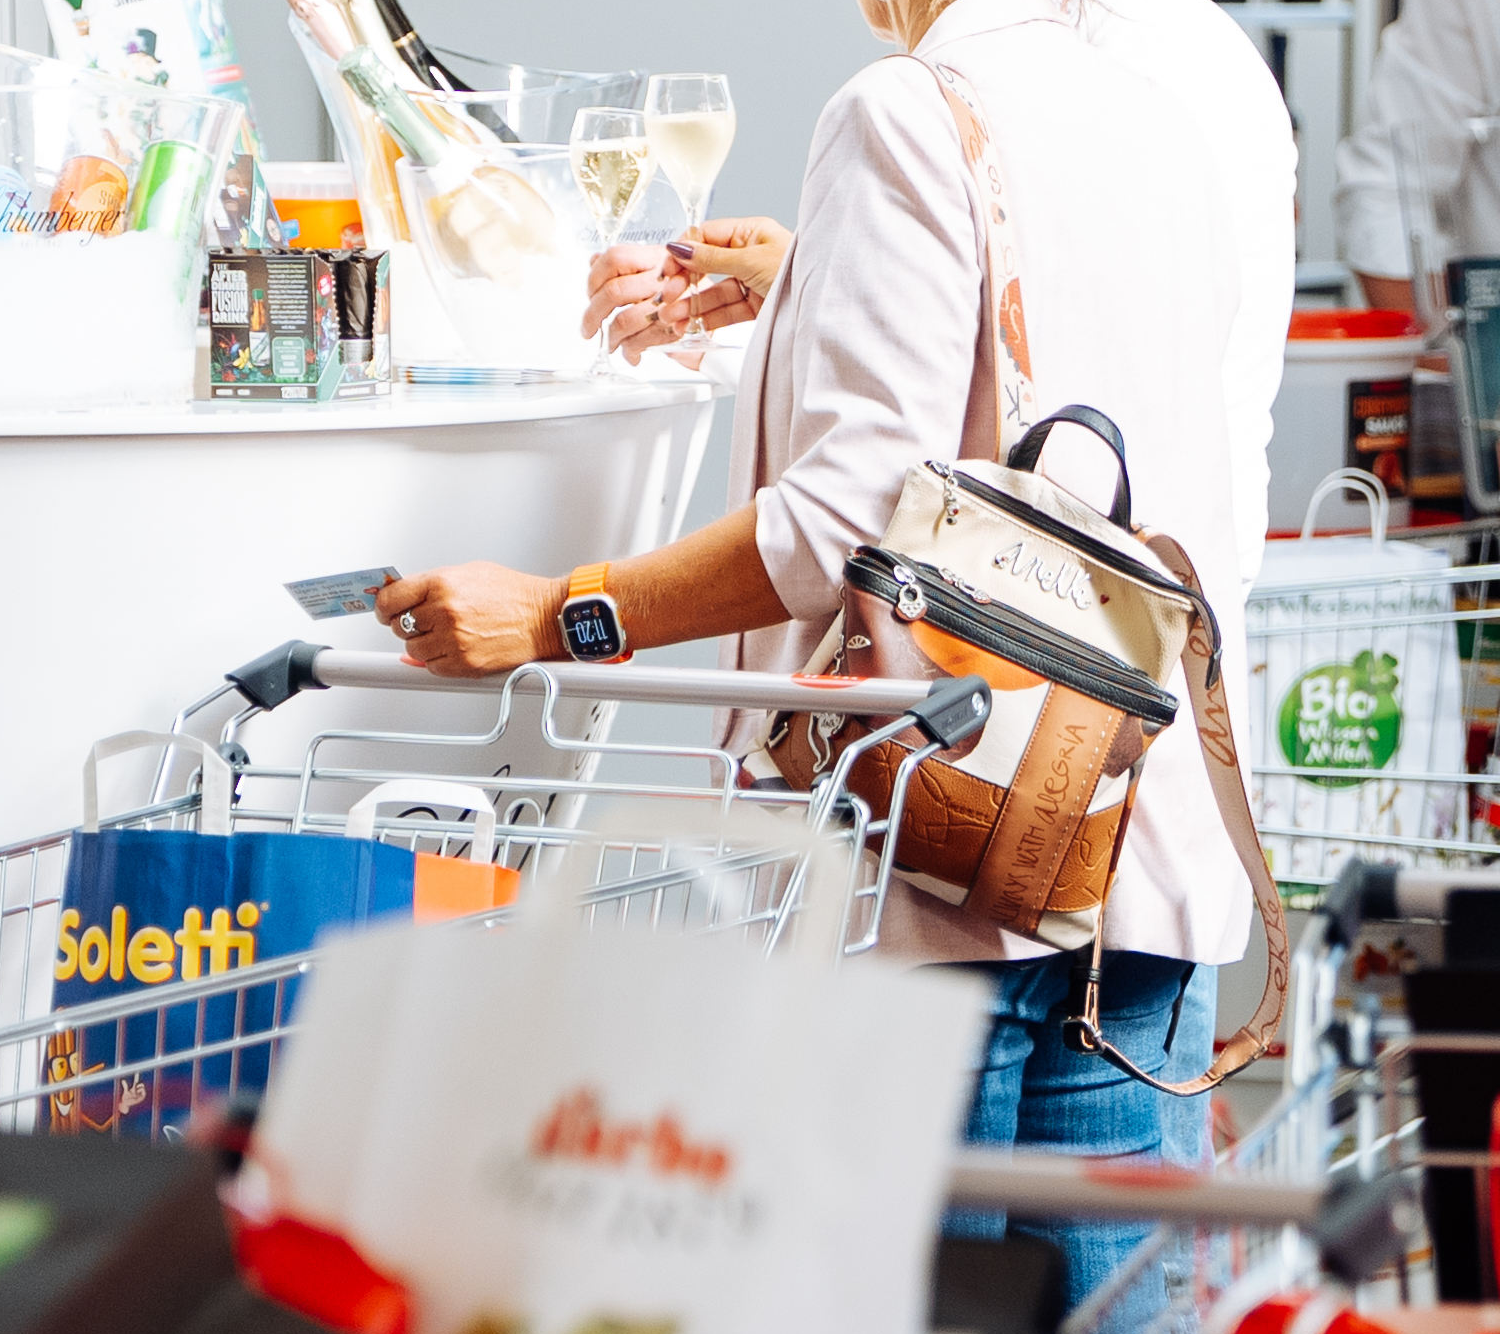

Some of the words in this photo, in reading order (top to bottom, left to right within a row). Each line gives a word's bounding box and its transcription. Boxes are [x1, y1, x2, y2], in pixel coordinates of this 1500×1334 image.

[211, 270, 247, 282] AFTER
[212, 281, 248, 291] DINNER
[212, 290, 248, 312] FUSION
[212, 311, 249, 324] DRINK
[1299, 675, 1378, 721] Bio
[53, 901, 256, 988] Soletti
